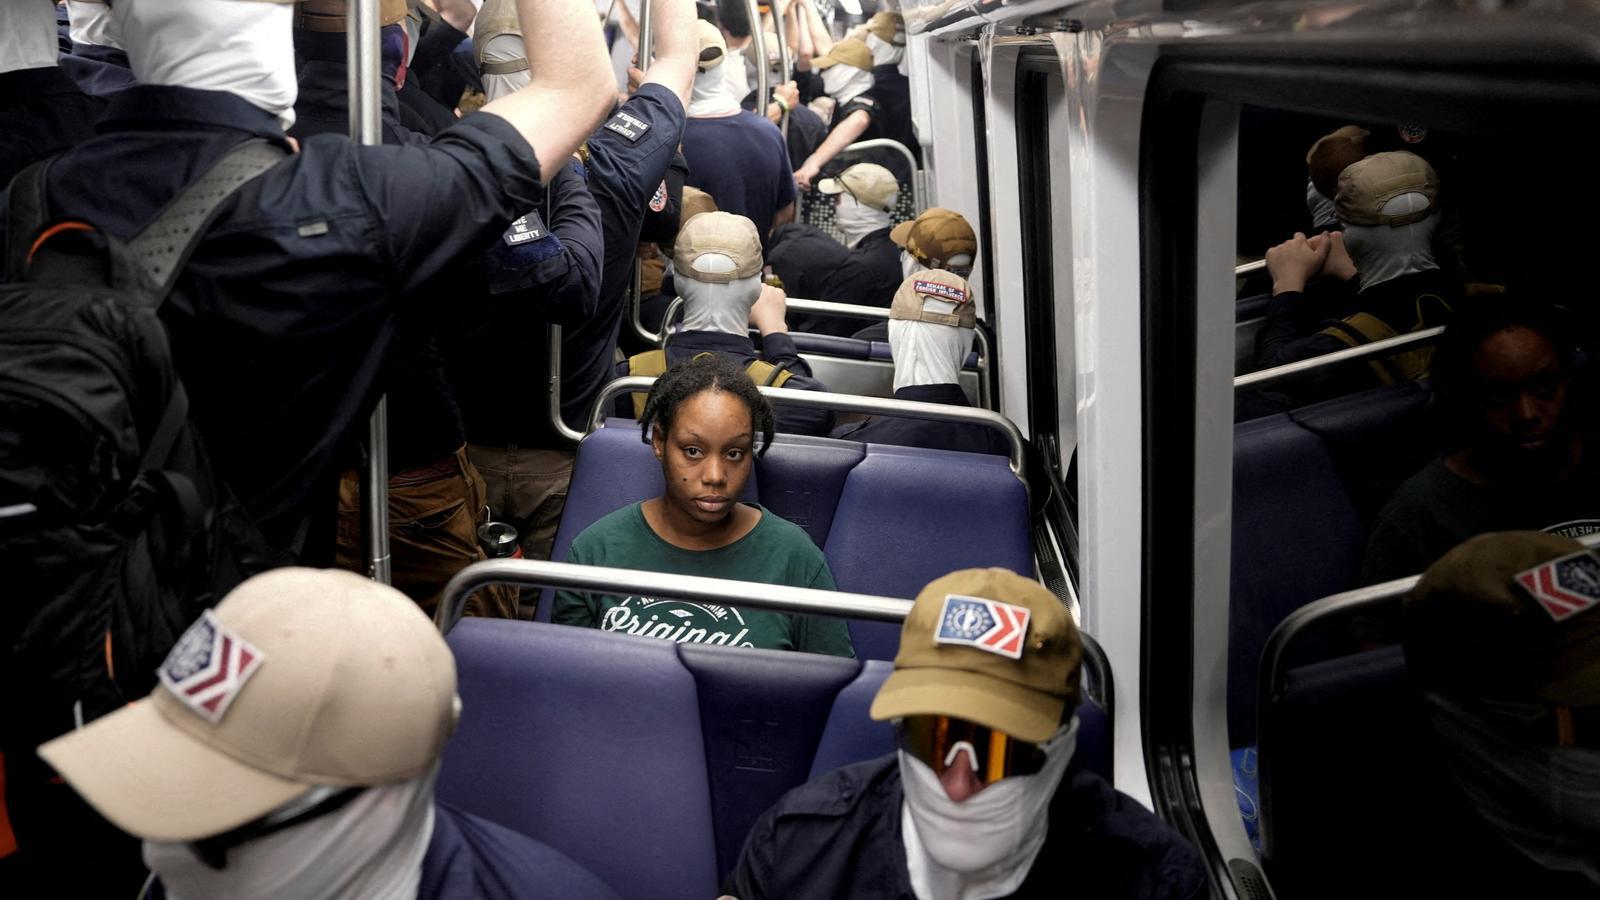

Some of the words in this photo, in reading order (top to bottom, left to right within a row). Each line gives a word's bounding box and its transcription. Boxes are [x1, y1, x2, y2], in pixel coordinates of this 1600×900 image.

[608, 123, 636, 138] LOYALTY
[515, 224, 528, 233] ME
[509, 230, 539, 242] LIBERTY
[916, 284, 936, 292] FOREIGN
